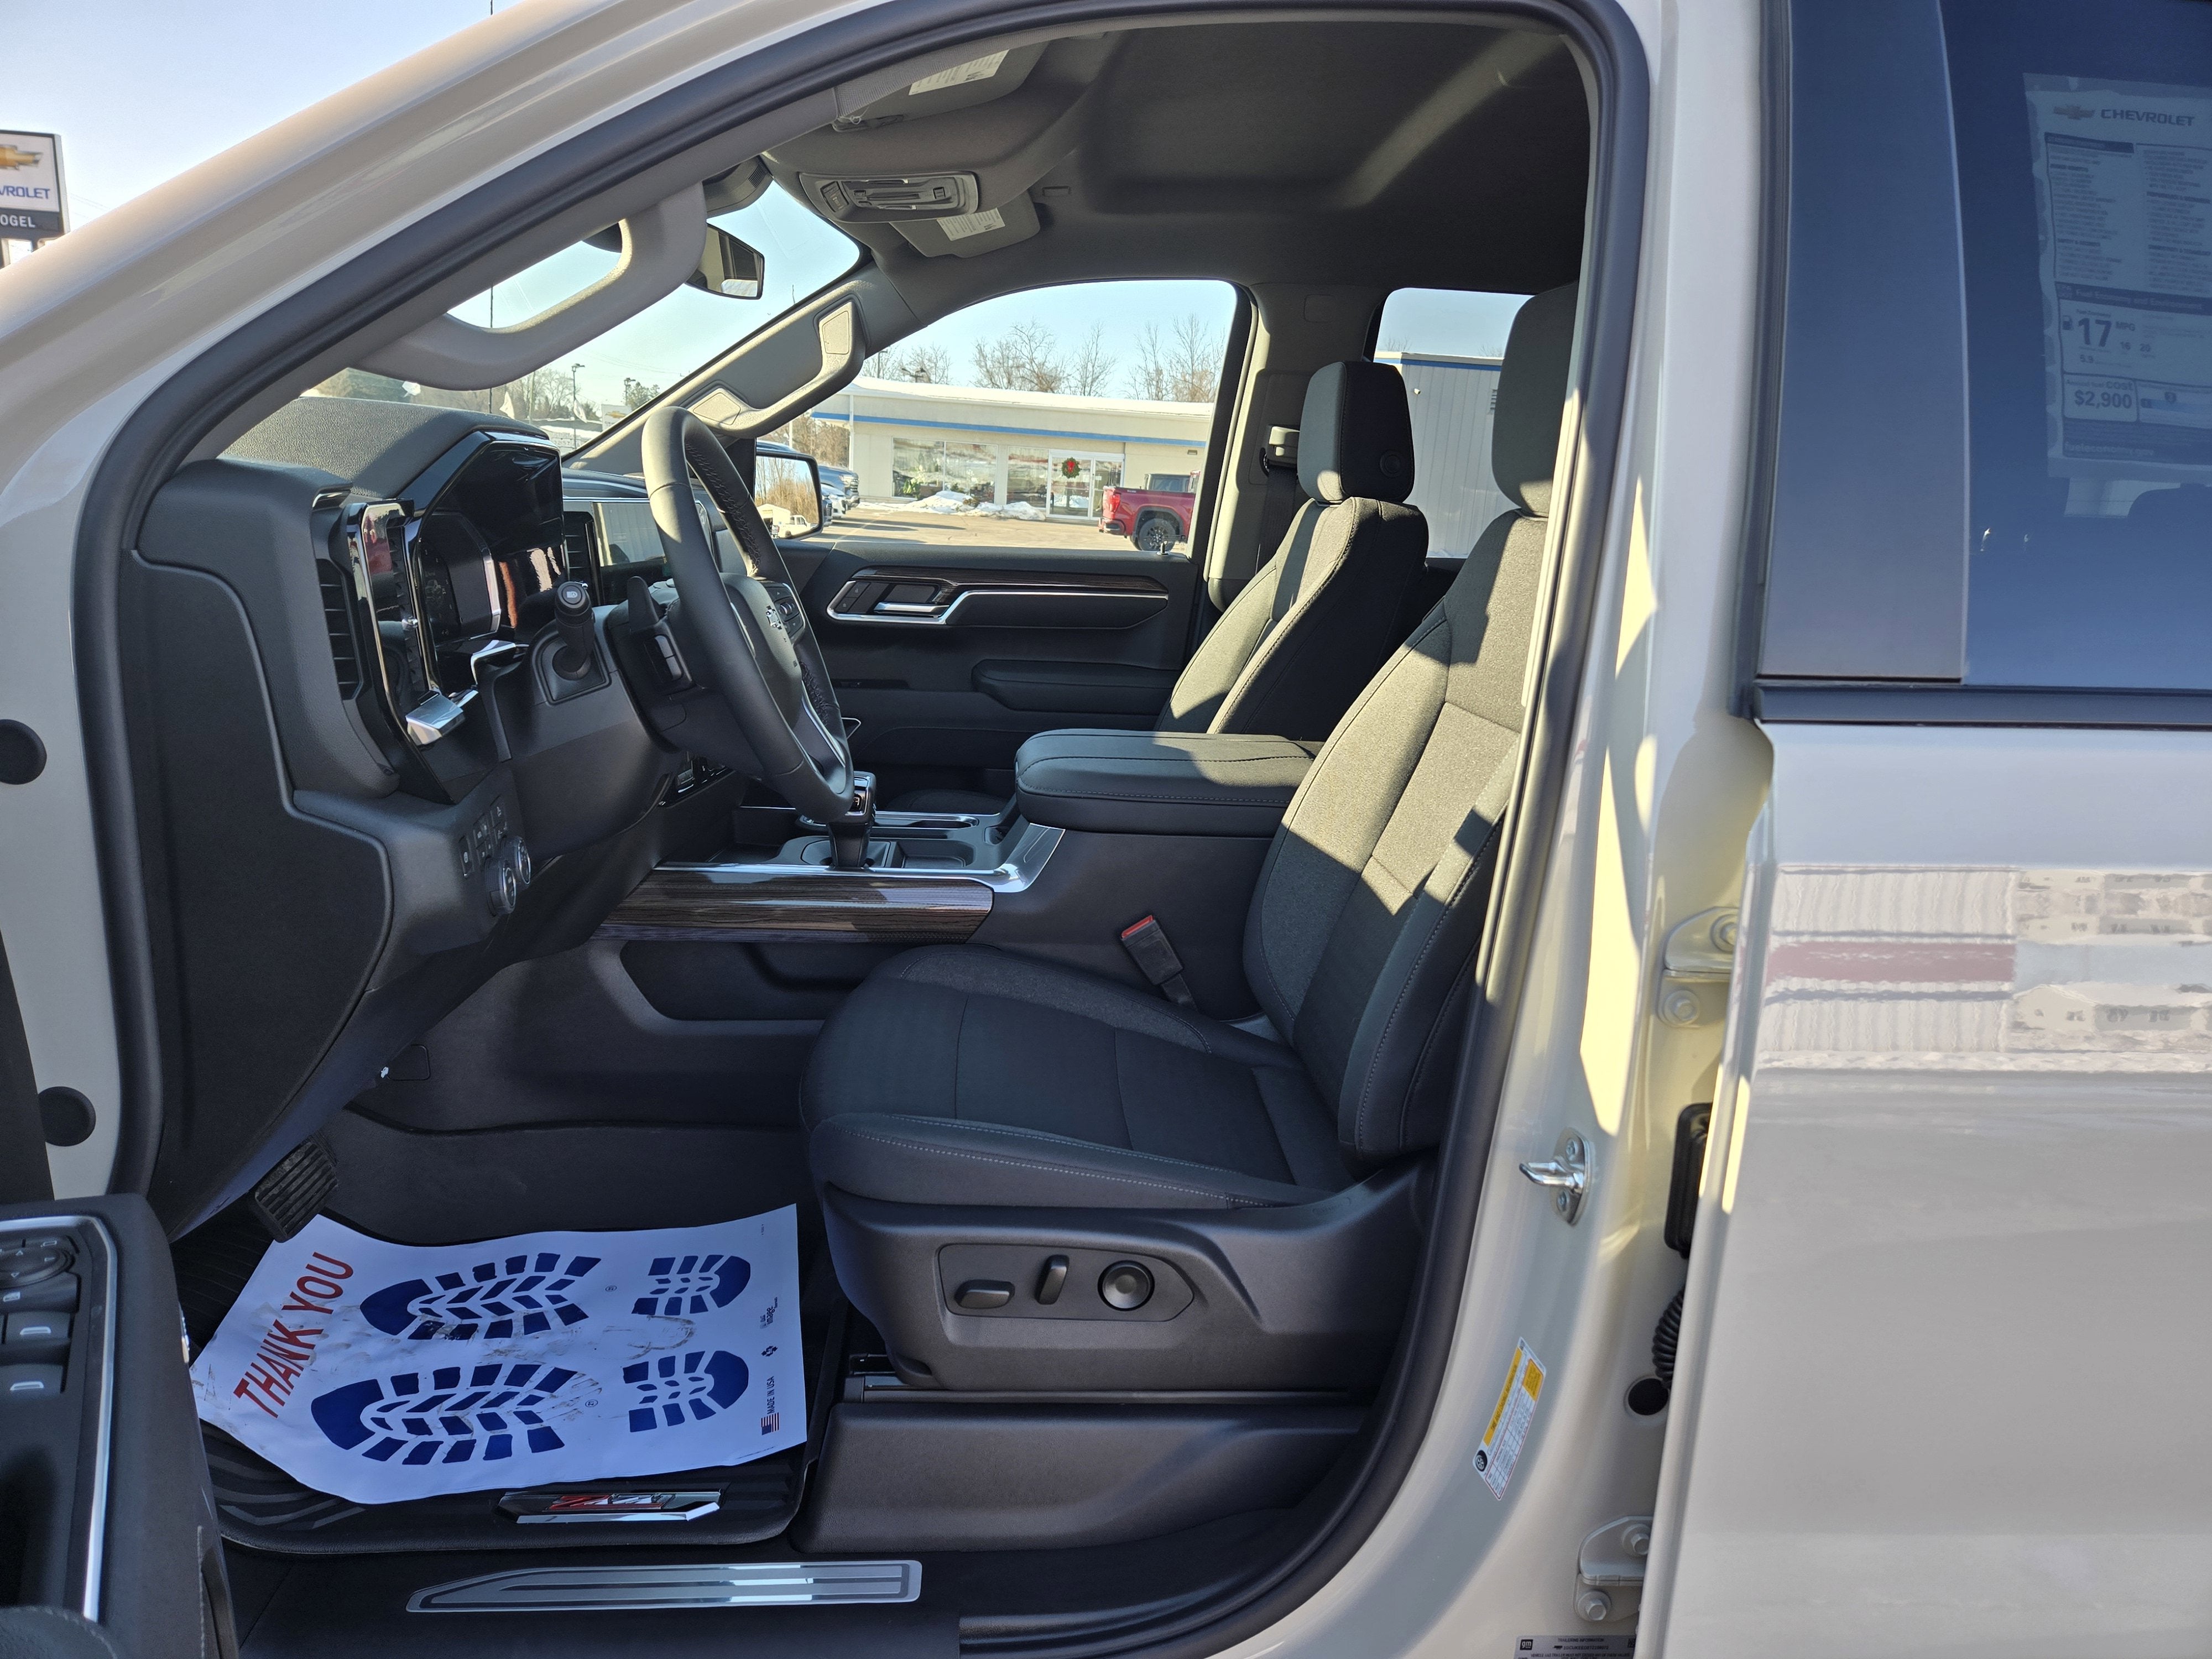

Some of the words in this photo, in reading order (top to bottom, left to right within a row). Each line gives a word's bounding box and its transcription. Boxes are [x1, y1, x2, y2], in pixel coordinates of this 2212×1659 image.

[2100, 109, 2196, 126] CHEVROLET
[0, 214, 36, 228] OGEL
[2078, 318, 2111, 347] 17
[2074, 390, 2132, 409] $2,900
[233, 1319, 324, 1418] THANK
[281, 1251, 353, 1314] YOU
